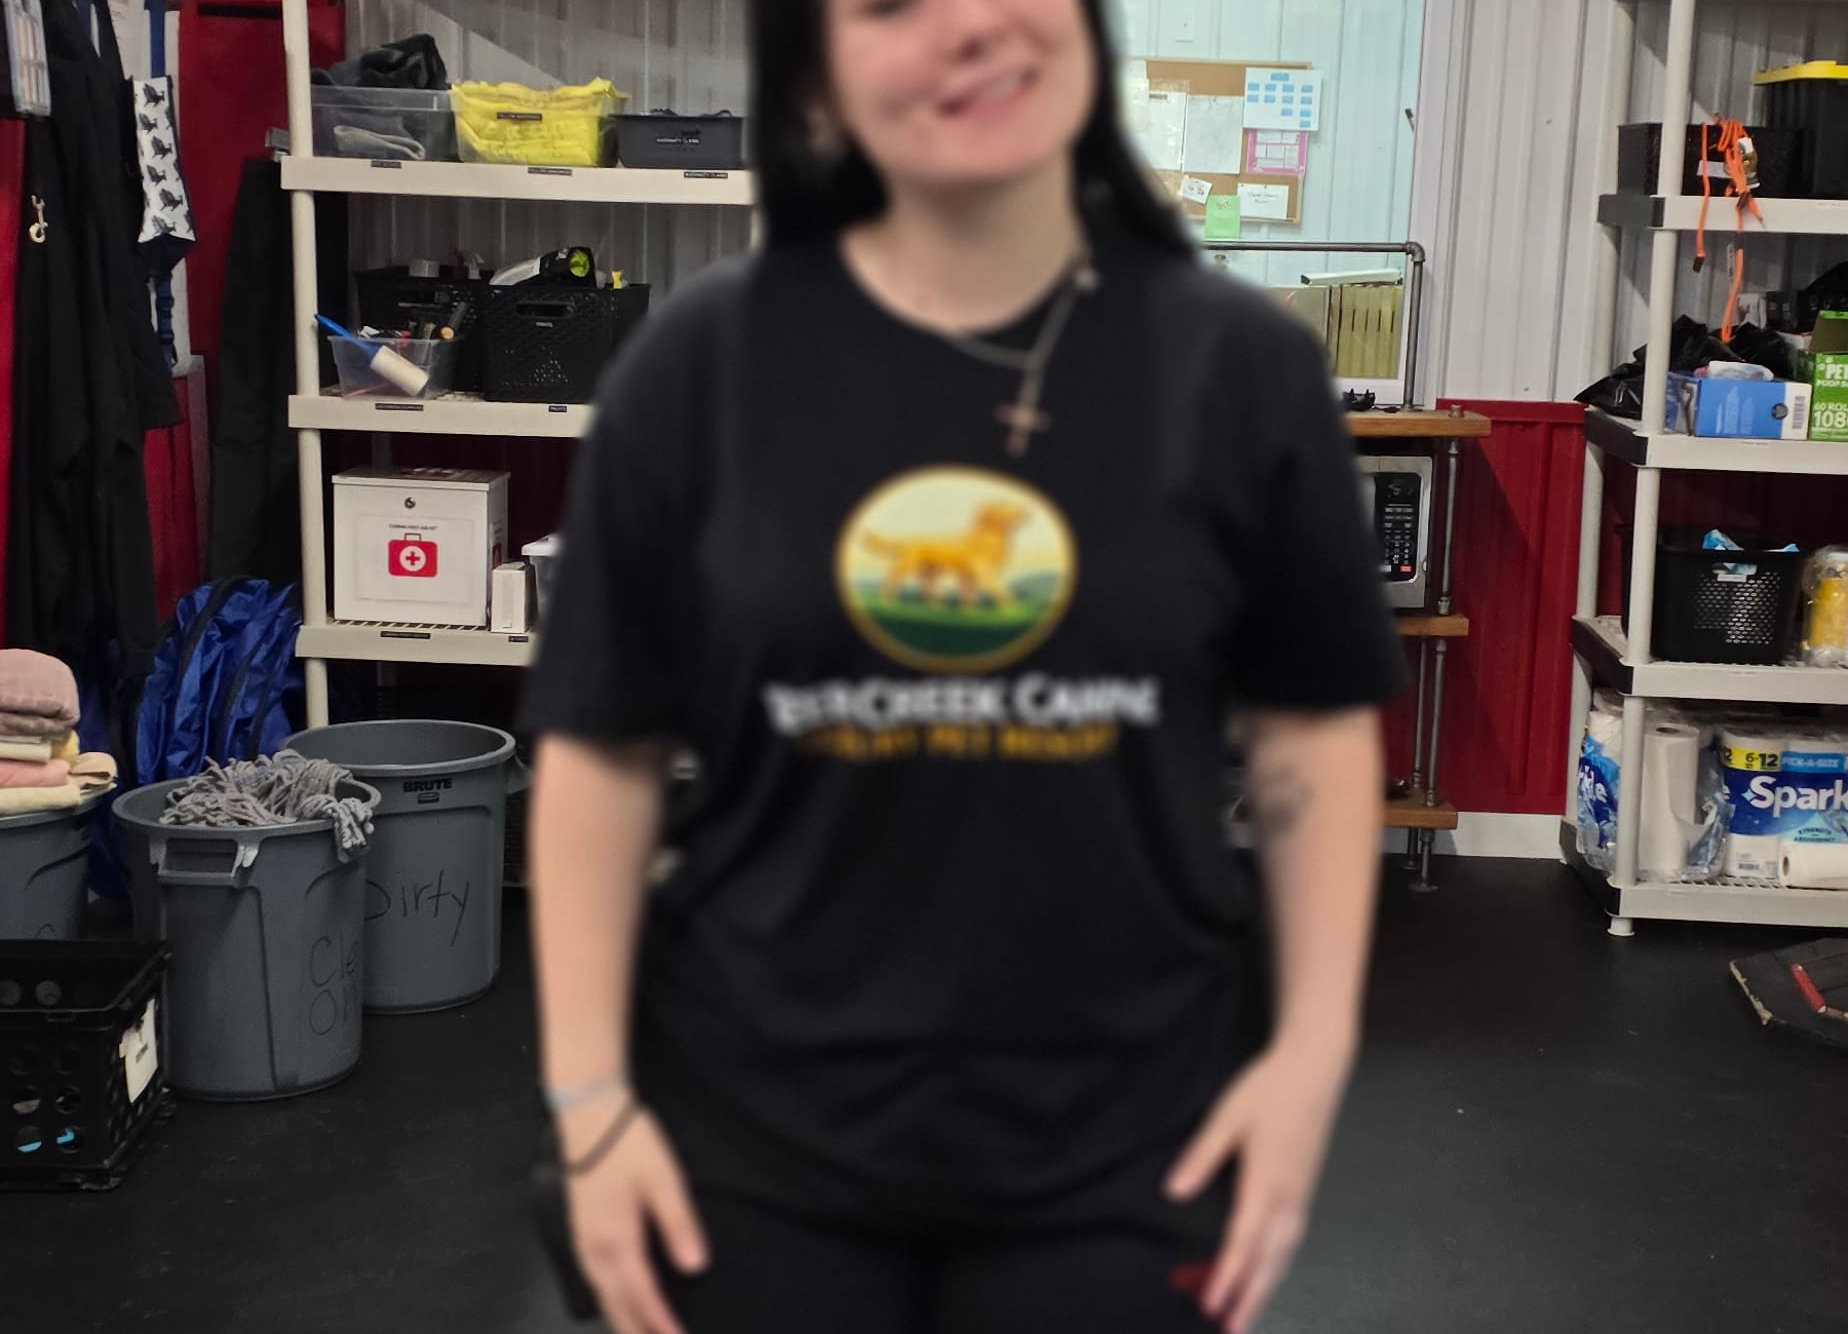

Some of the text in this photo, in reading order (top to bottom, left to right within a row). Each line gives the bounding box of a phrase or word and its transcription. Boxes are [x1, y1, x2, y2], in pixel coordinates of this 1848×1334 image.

[1814, 410, 1848, 428] 108
[403, 778, 452, 793] BRUTE
[1750, 775, 1848, 818] Spark
[365, 870, 470, 947] Dirty
